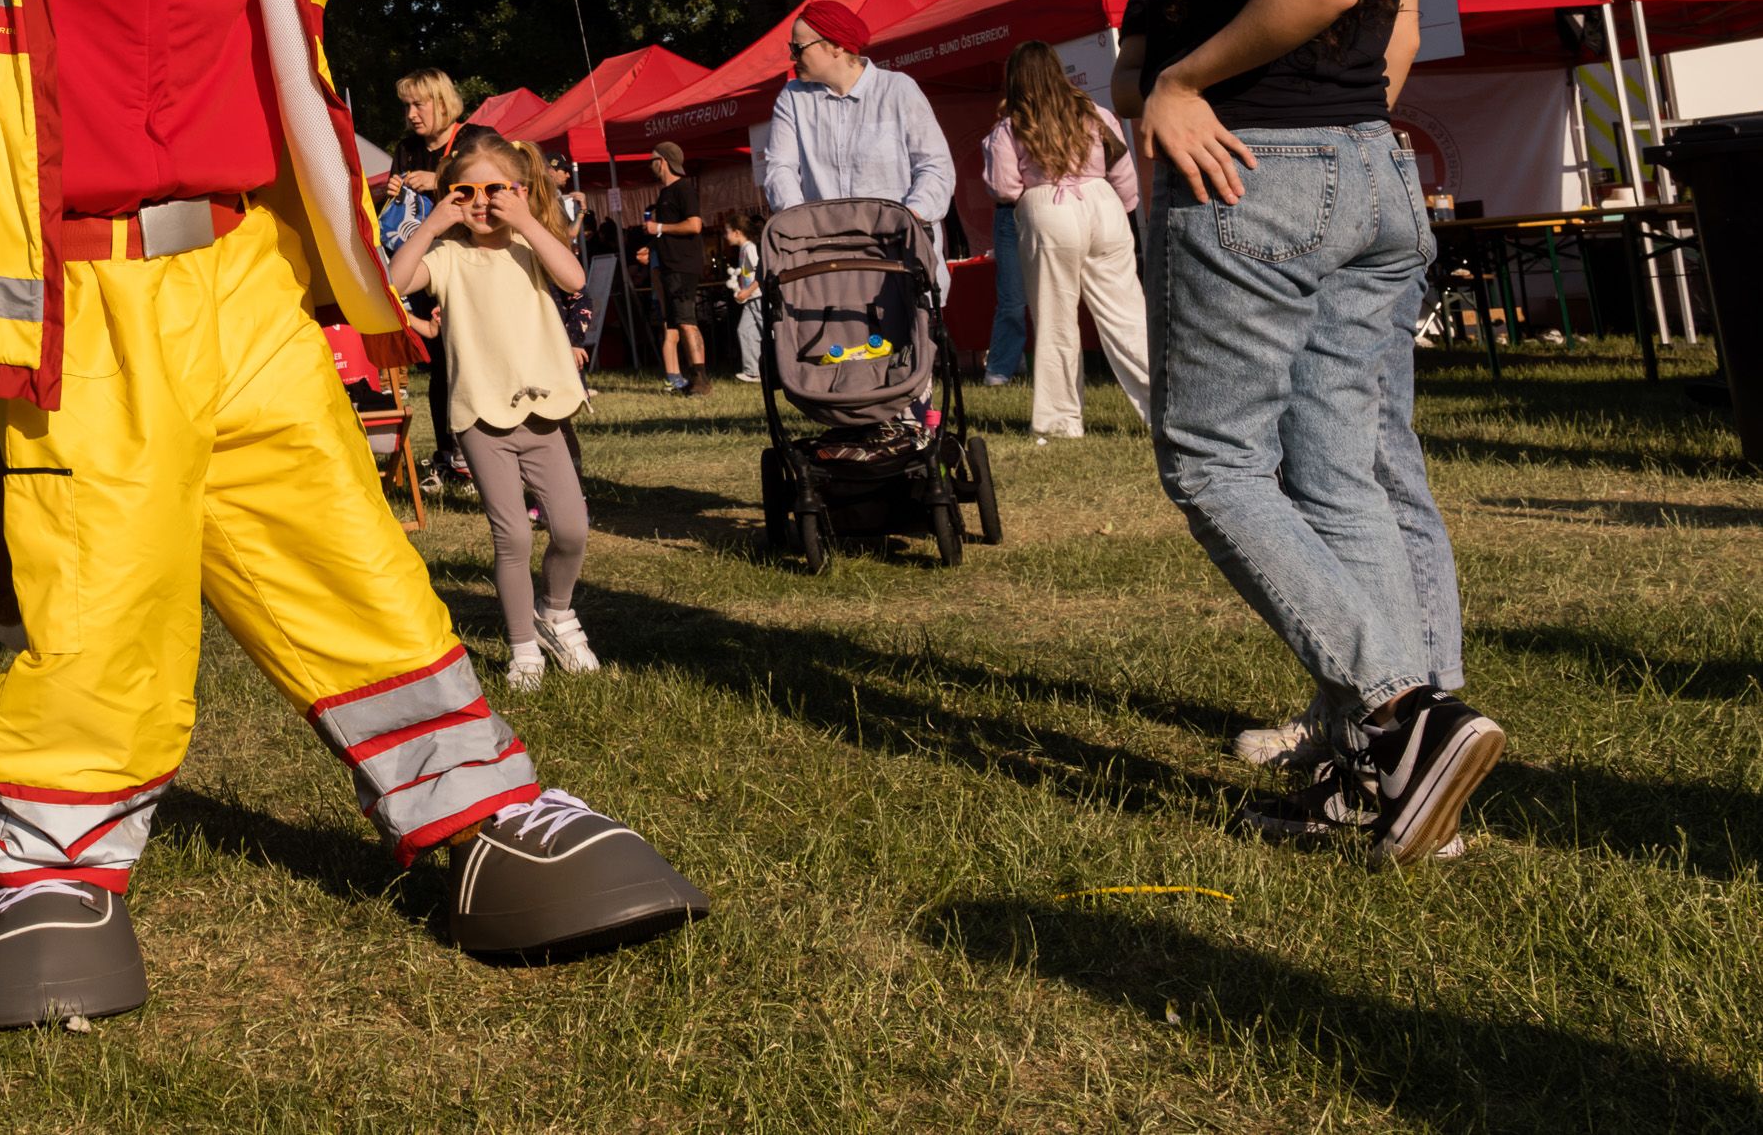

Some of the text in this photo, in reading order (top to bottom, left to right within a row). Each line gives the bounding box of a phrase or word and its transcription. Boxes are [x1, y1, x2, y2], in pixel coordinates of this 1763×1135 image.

[895, 46, 935, 69] SAMARITER
[939, 39, 960, 56] BUND
[644, 99, 739, 137] SAMARITERBUND
